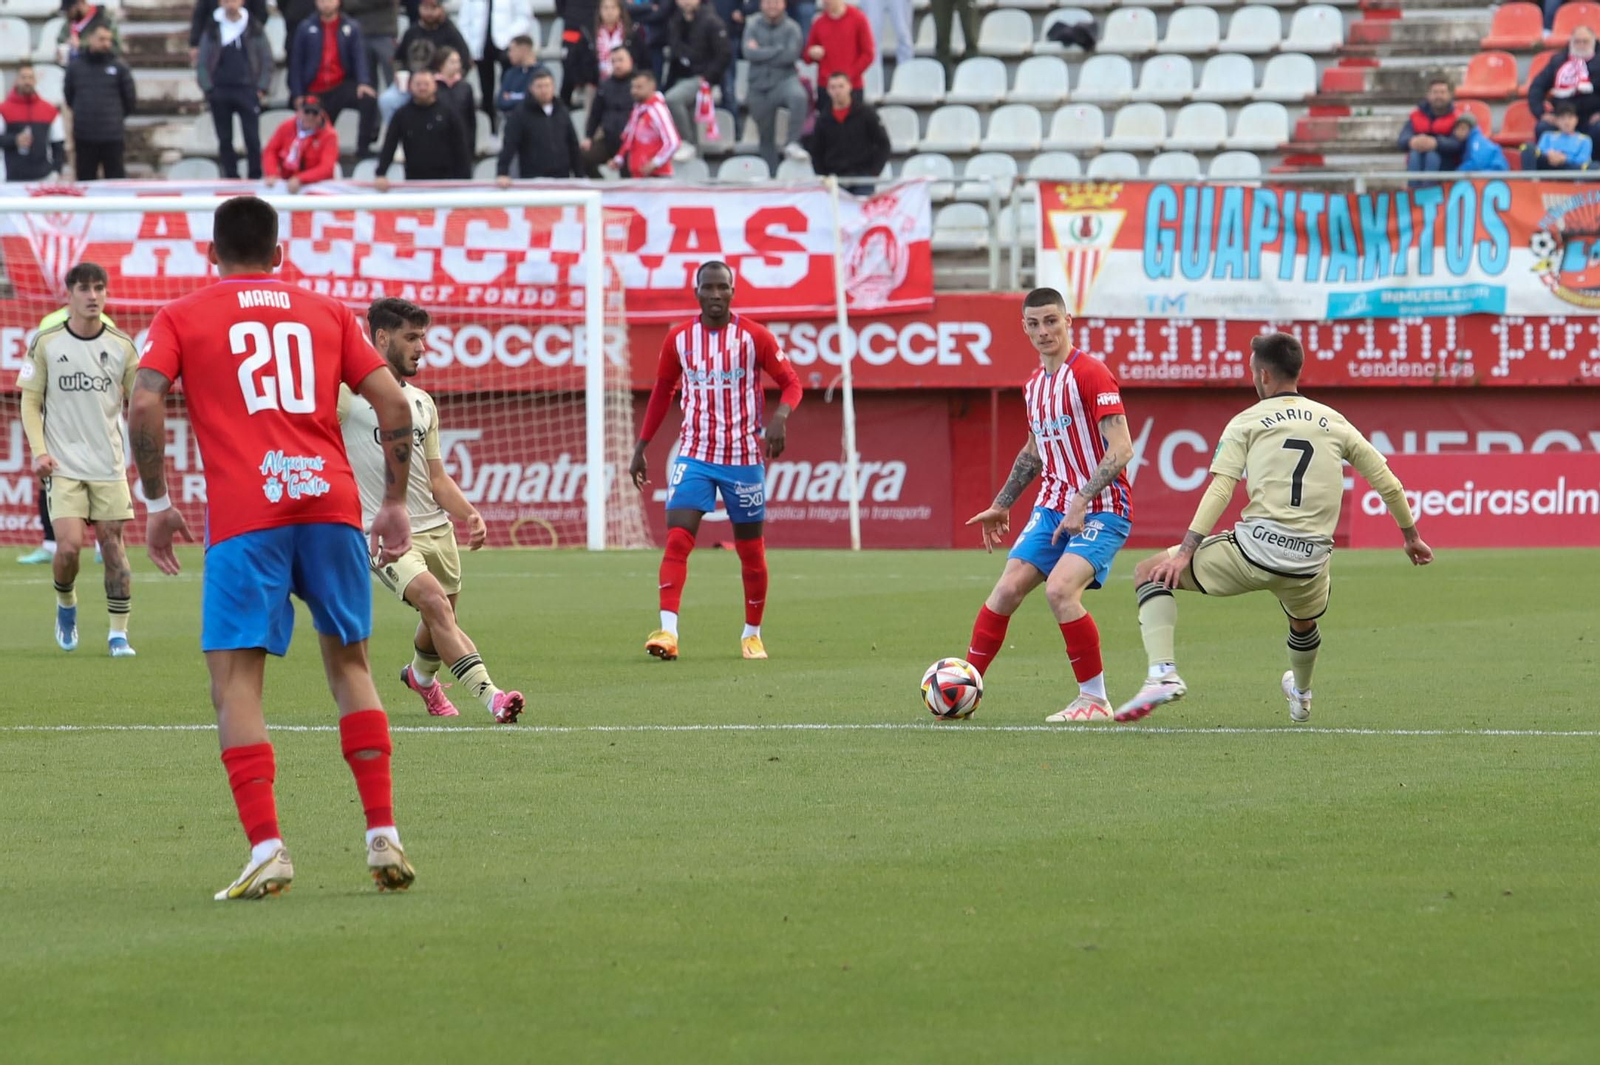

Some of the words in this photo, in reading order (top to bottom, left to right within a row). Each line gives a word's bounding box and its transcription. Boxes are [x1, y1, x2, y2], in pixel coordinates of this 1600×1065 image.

[120, 193, 810, 290] AGECIRAS
[1143, 180, 1512, 284] GUAPITAKITOS
[237, 290, 291, 310] MARIO
[475, 286, 557, 306] FONDO
[228, 321, 316, 415] 20
[416, 324, 626, 369] SOCCER
[59, 372, 112, 392] wiber
[1119, 362, 1245, 380] tendencias
[1260, 407, 1313, 430] MARIO
[1318, 415, 1331, 433] G.
[765, 452, 907, 502] matra
[1281, 437, 1314, 508] 7
[1362, 475, 1599, 523] agecirasalm
[1252, 524, 1315, 557] Greening
